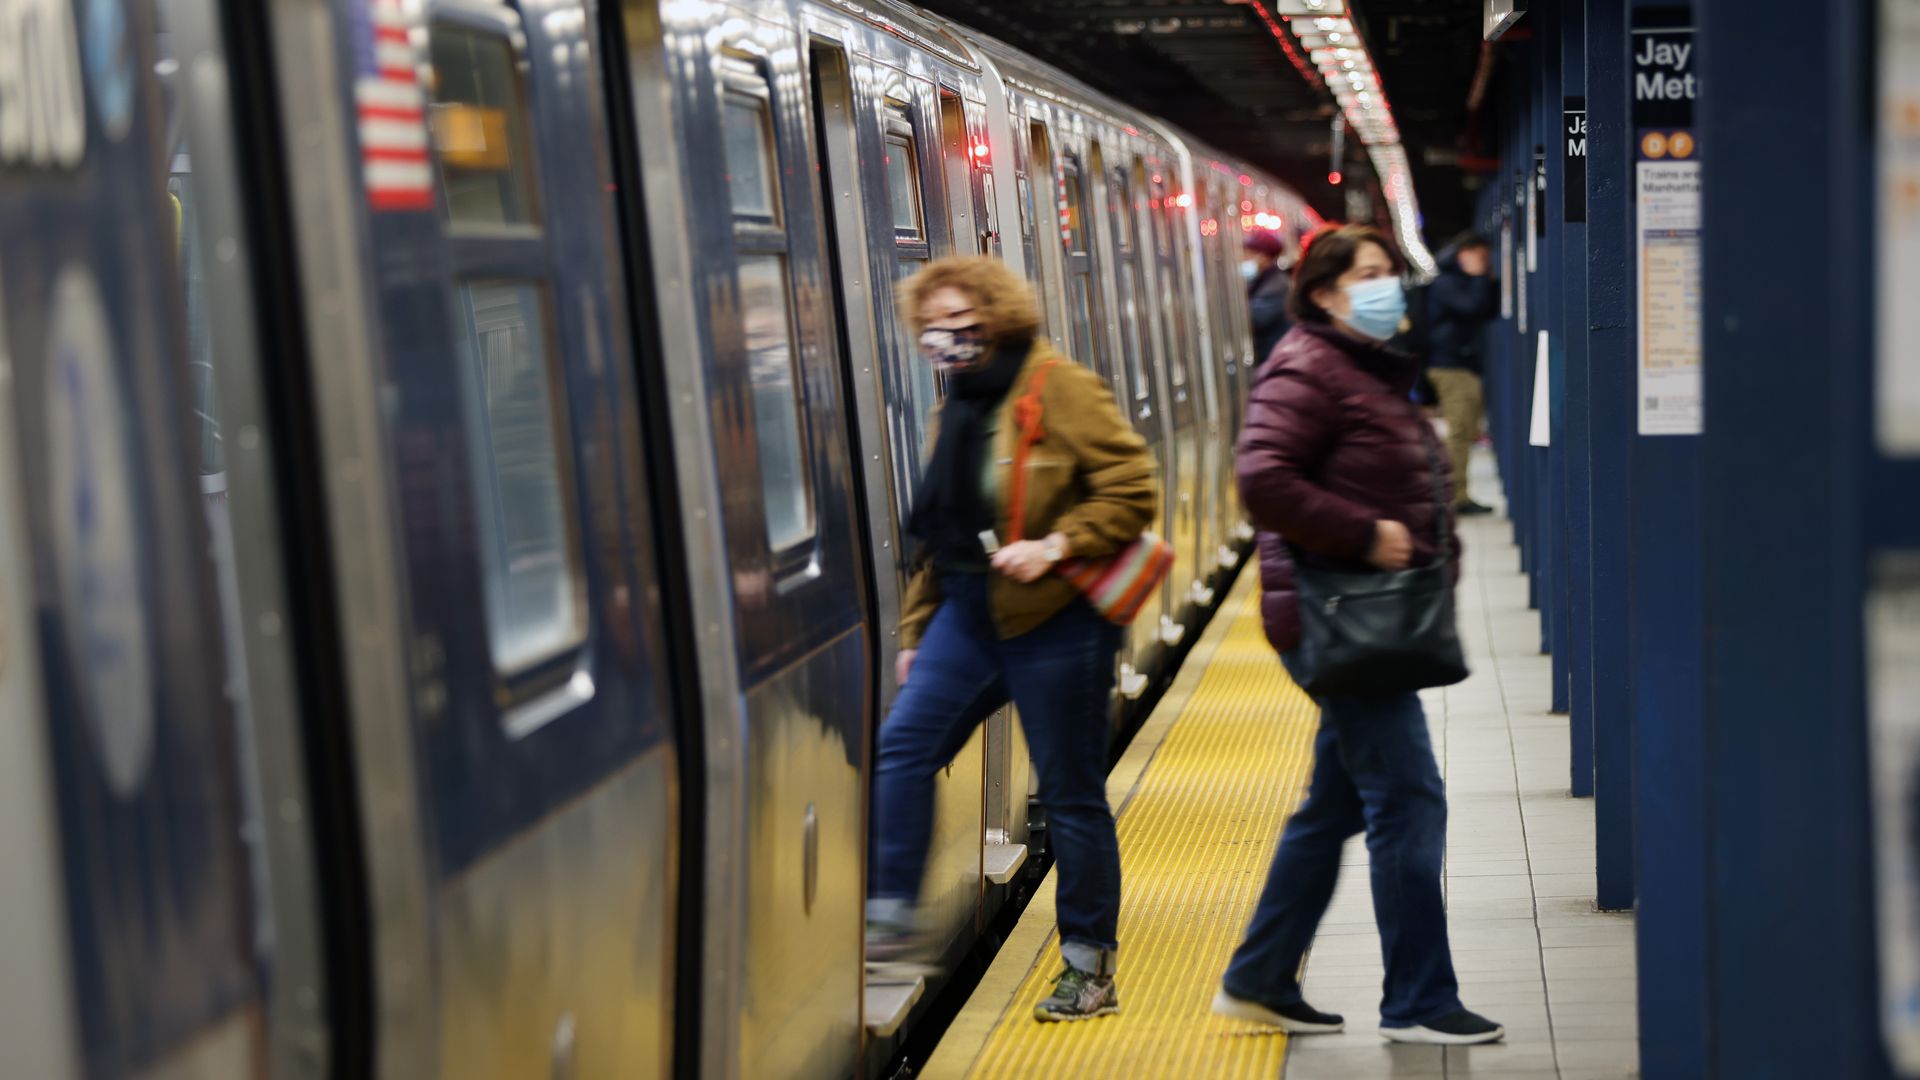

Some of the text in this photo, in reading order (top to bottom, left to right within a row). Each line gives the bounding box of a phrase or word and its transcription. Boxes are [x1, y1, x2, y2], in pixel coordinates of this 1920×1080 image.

[1636, 38, 1691, 71] Jay
[1636, 72, 1696, 100] Met
[1643, 168, 1679, 180] Trains
